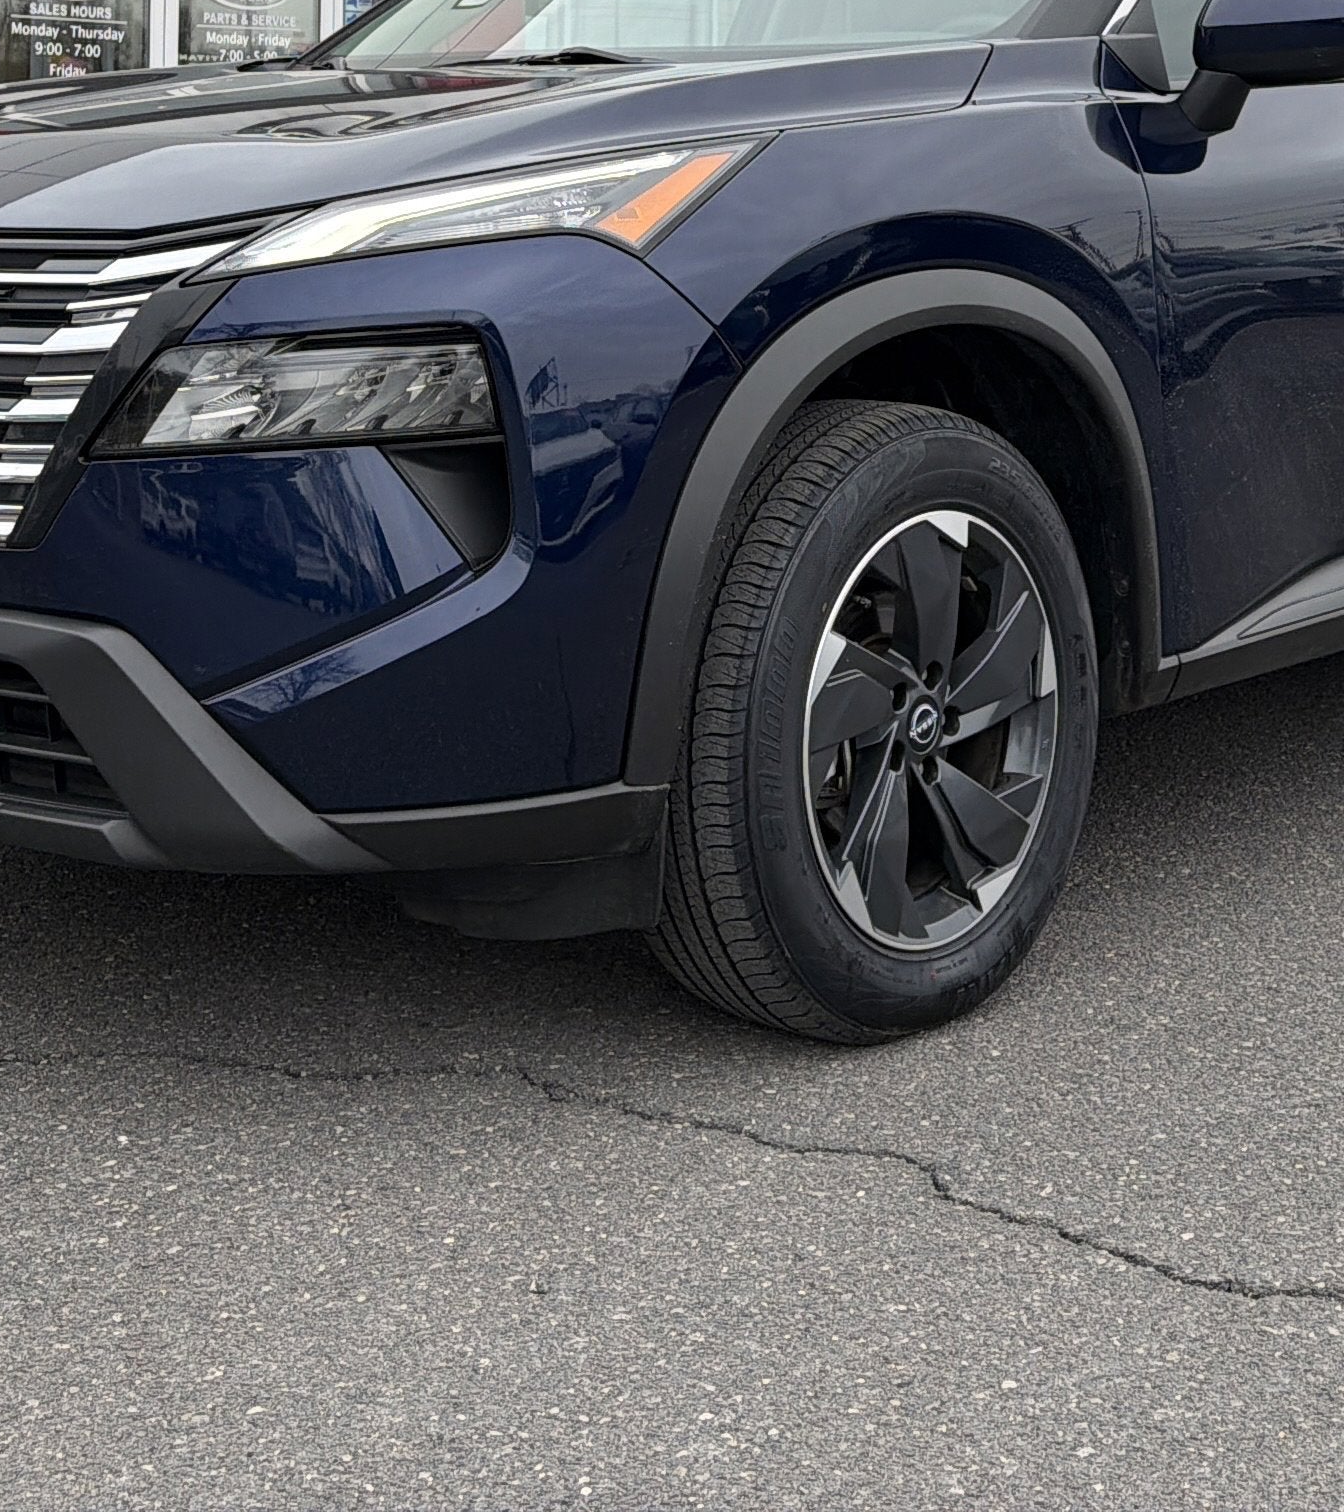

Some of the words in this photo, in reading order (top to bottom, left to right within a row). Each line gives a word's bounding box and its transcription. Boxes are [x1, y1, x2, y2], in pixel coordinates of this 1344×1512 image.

[29, 1, 68, 17] SALES
[70, 5, 112, 19] HOURS
[203, 12, 237, 25] PARTS
[240, 14, 249, 25] &
[251, 15, 297, 28] SERVICE
[10, 21, 60, 39] Monday
[69, 25, 126, 43] Thursday
[206, 31, 250, 48] Monday
[258, 34, 292, 48] Friday
[35, 42, 63, 56] 9:00
[74, 43, 101, 58] 7:00
[219, 49, 244, 62] 7:00
[49, 63, 87, 77] Friday
